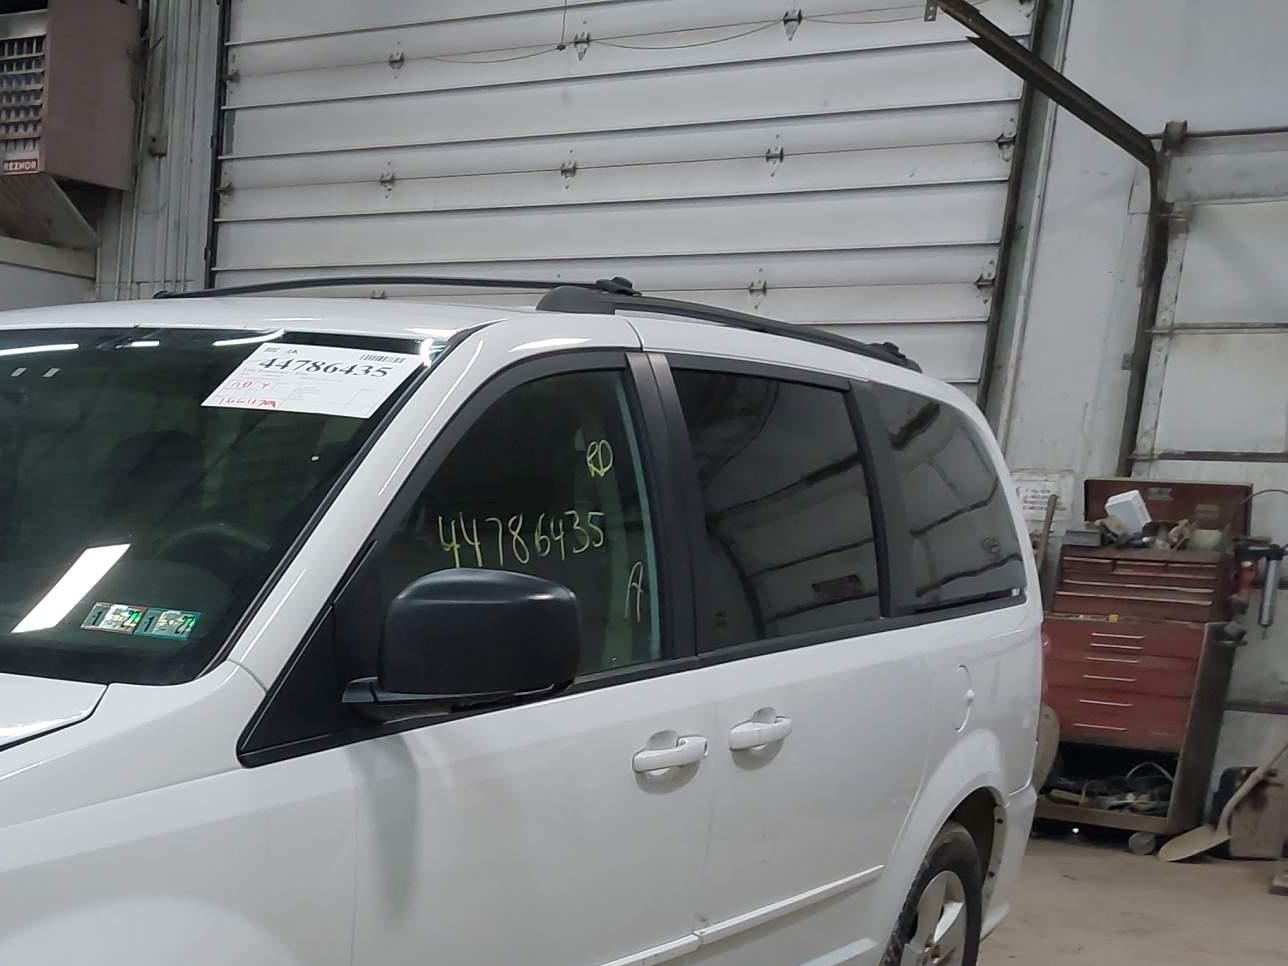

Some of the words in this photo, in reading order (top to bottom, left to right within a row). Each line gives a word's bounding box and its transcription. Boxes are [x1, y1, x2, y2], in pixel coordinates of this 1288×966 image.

[259, 357, 393, 378] 44786435
[437, 509, 605, 569] 44786435
[624, 561, 644, 623] A
[144, 615, 155, 633] 1
